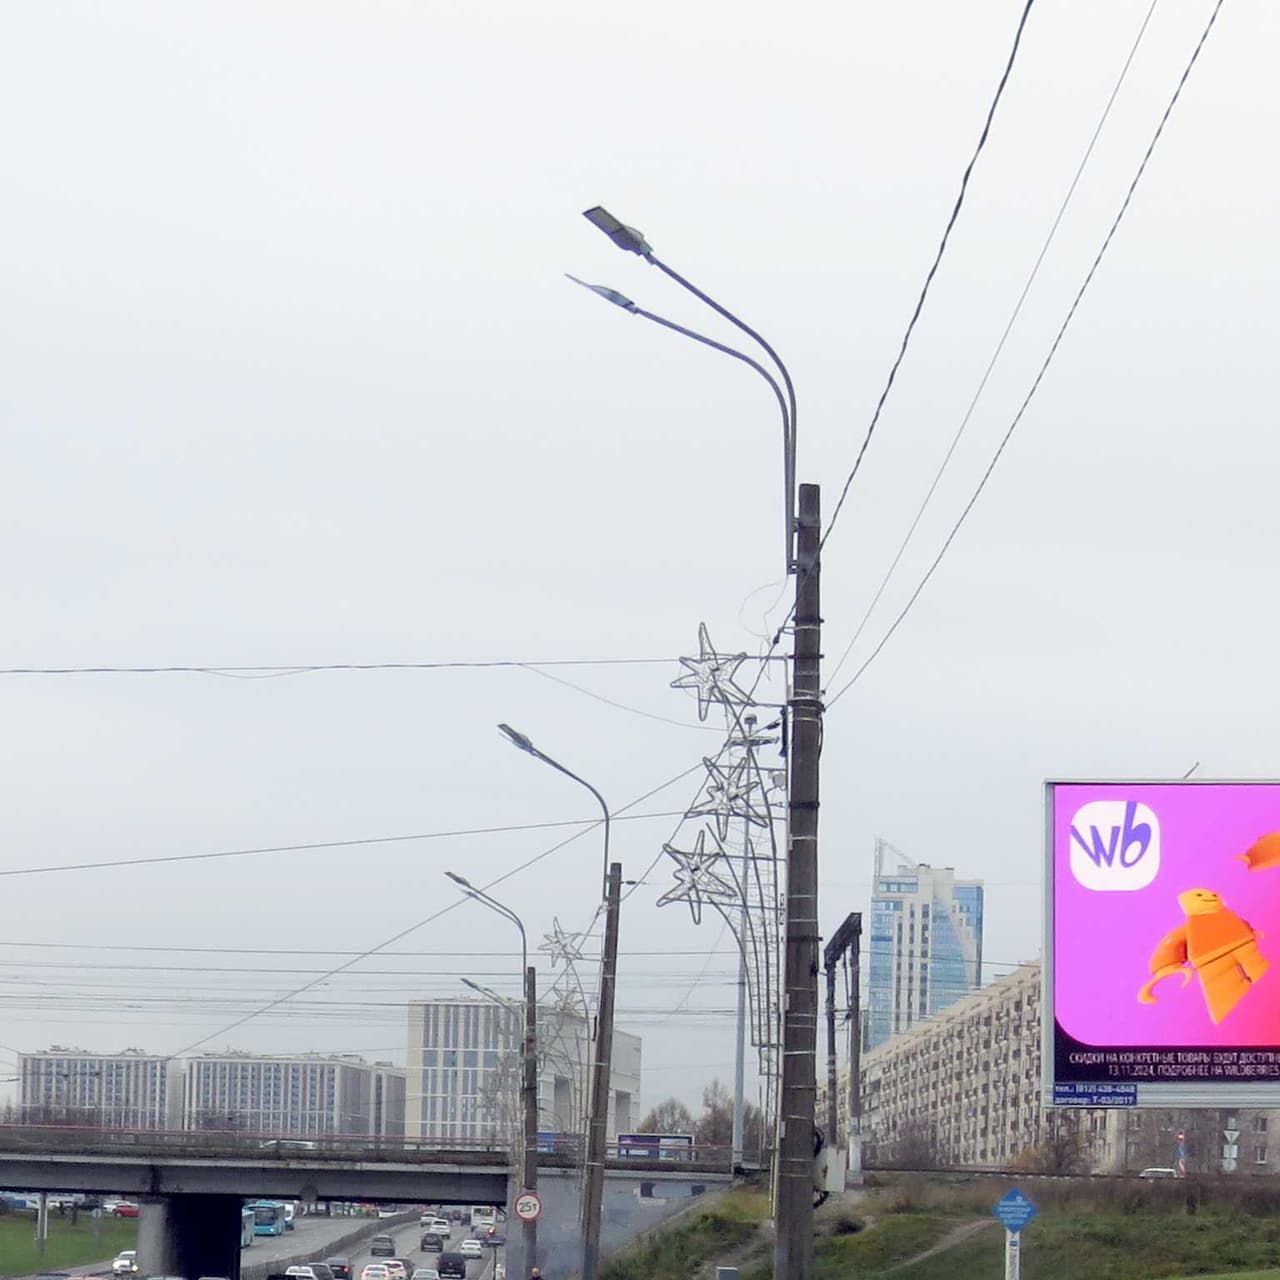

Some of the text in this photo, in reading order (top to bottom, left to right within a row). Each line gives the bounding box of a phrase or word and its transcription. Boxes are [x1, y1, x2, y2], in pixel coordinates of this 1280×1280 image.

[1069, 1053, 1104, 1064] СКИДКИ
[1106, 1053, 1118, 1064] НА
[1120, 1053, 1175, 1064] КОНКРЕТНЫЕ
[1177, 1053, 1211, 1064] ТОВАРЫ
[1211, 1065, 1223, 1076] НА
